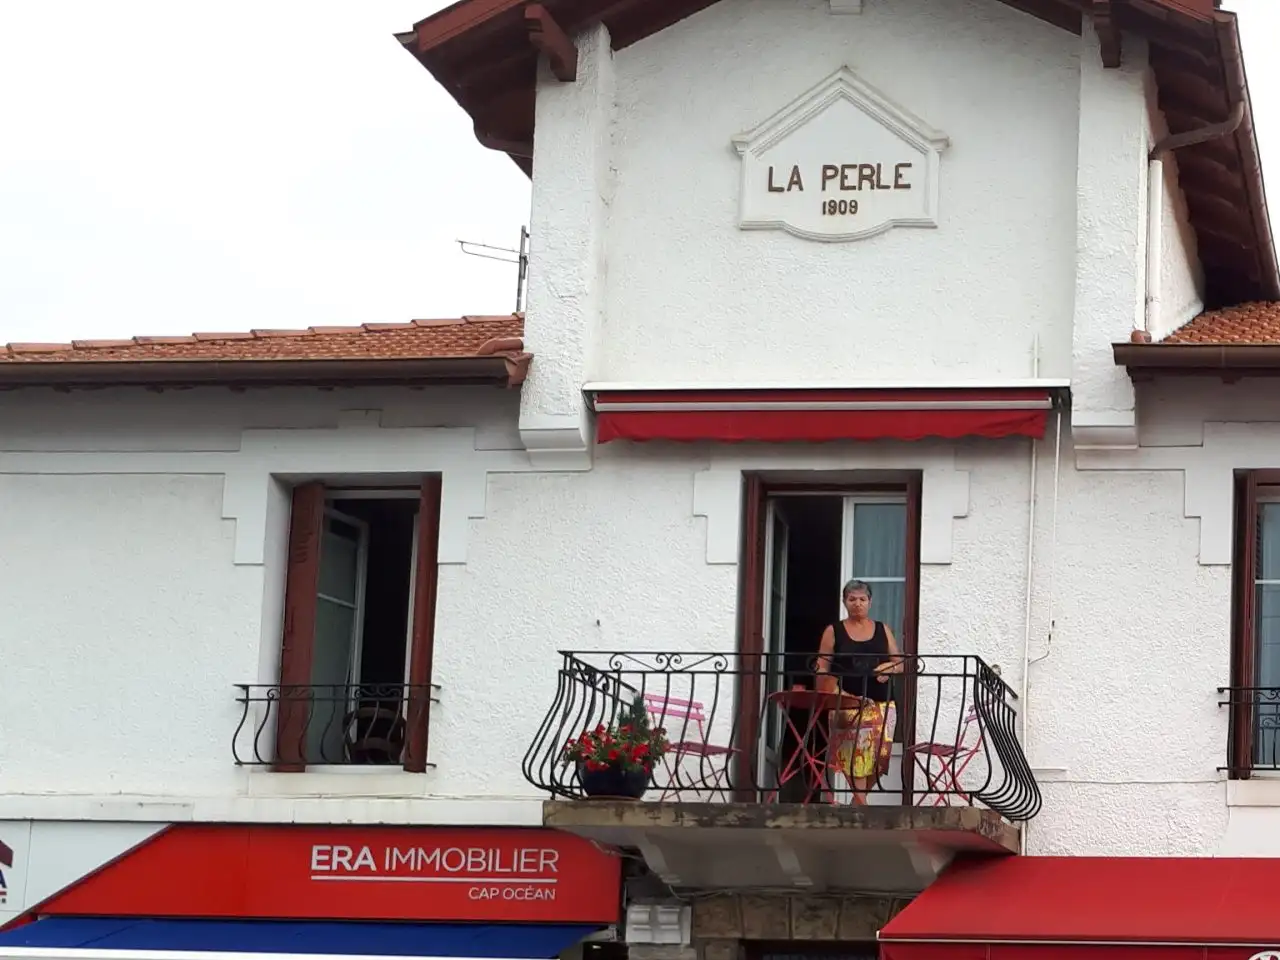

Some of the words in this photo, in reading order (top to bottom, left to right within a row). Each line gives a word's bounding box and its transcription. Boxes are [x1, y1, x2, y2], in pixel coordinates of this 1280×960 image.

[767, 164, 804, 193] LA
[820, 162, 913, 192] PERLE
[821, 198, 859, 216] 1909
[310, 844, 377, 872] ERA
[384, 846, 560, 873] IMMOBILIER
[467, 886, 500, 900] CAP
[502, 885, 556, 901] OCÉAN
